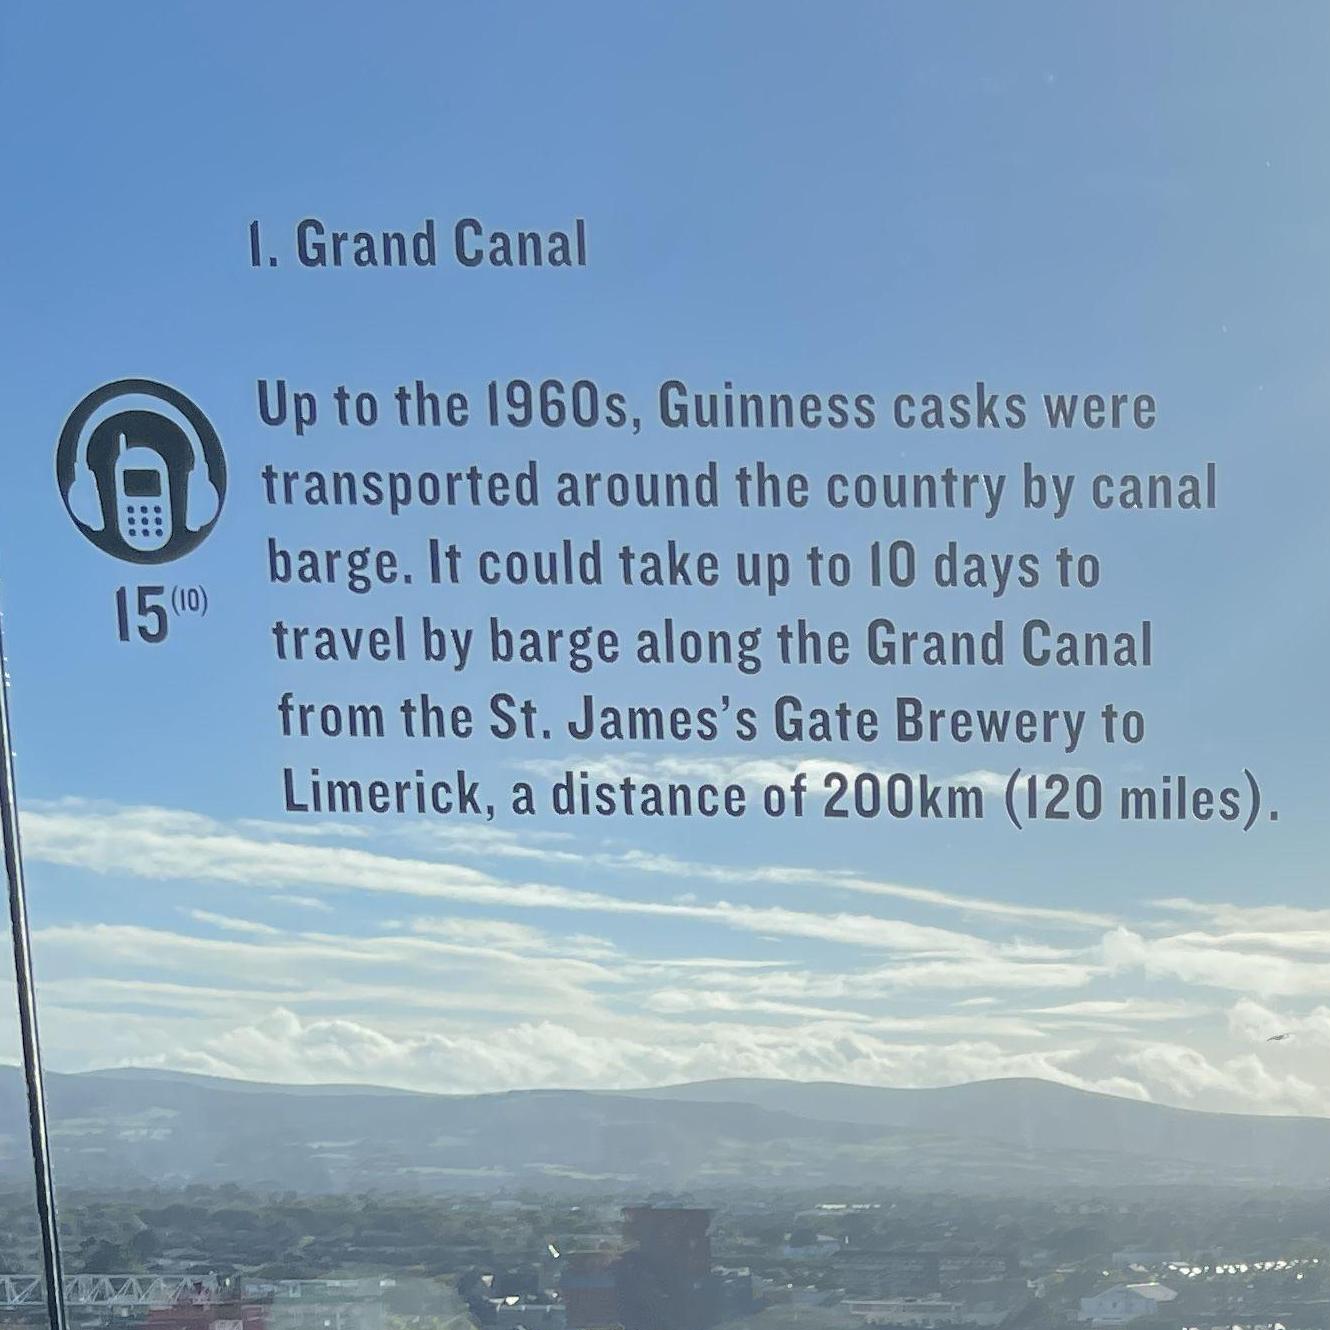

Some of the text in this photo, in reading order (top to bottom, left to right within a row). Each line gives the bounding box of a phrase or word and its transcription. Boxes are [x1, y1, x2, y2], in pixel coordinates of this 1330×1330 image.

[296, 218, 437, 268] Grand
[454, 218, 587, 268] Canal
[257, 379, 1156, 437] Up to the 1960s, Guinness casks were
[261, 459, 1216, 520] transported around the country by canal
[267, 536, 1100, 599] barge. It could take up to 10 days to
[271, 615, 1152, 675] travel by barge along the Grand Canal
[276, 691, 385, 738] from
[399, 692, 473, 739] the
[489, 692, 551, 740] St.
[774, 695, 879, 743] Gate
[895, 696, 1086, 754] Brewery
[1101, 703, 1145, 744] to
[283, 767, 1278, 832] Limerick, a distance of 200km (120 miles).
